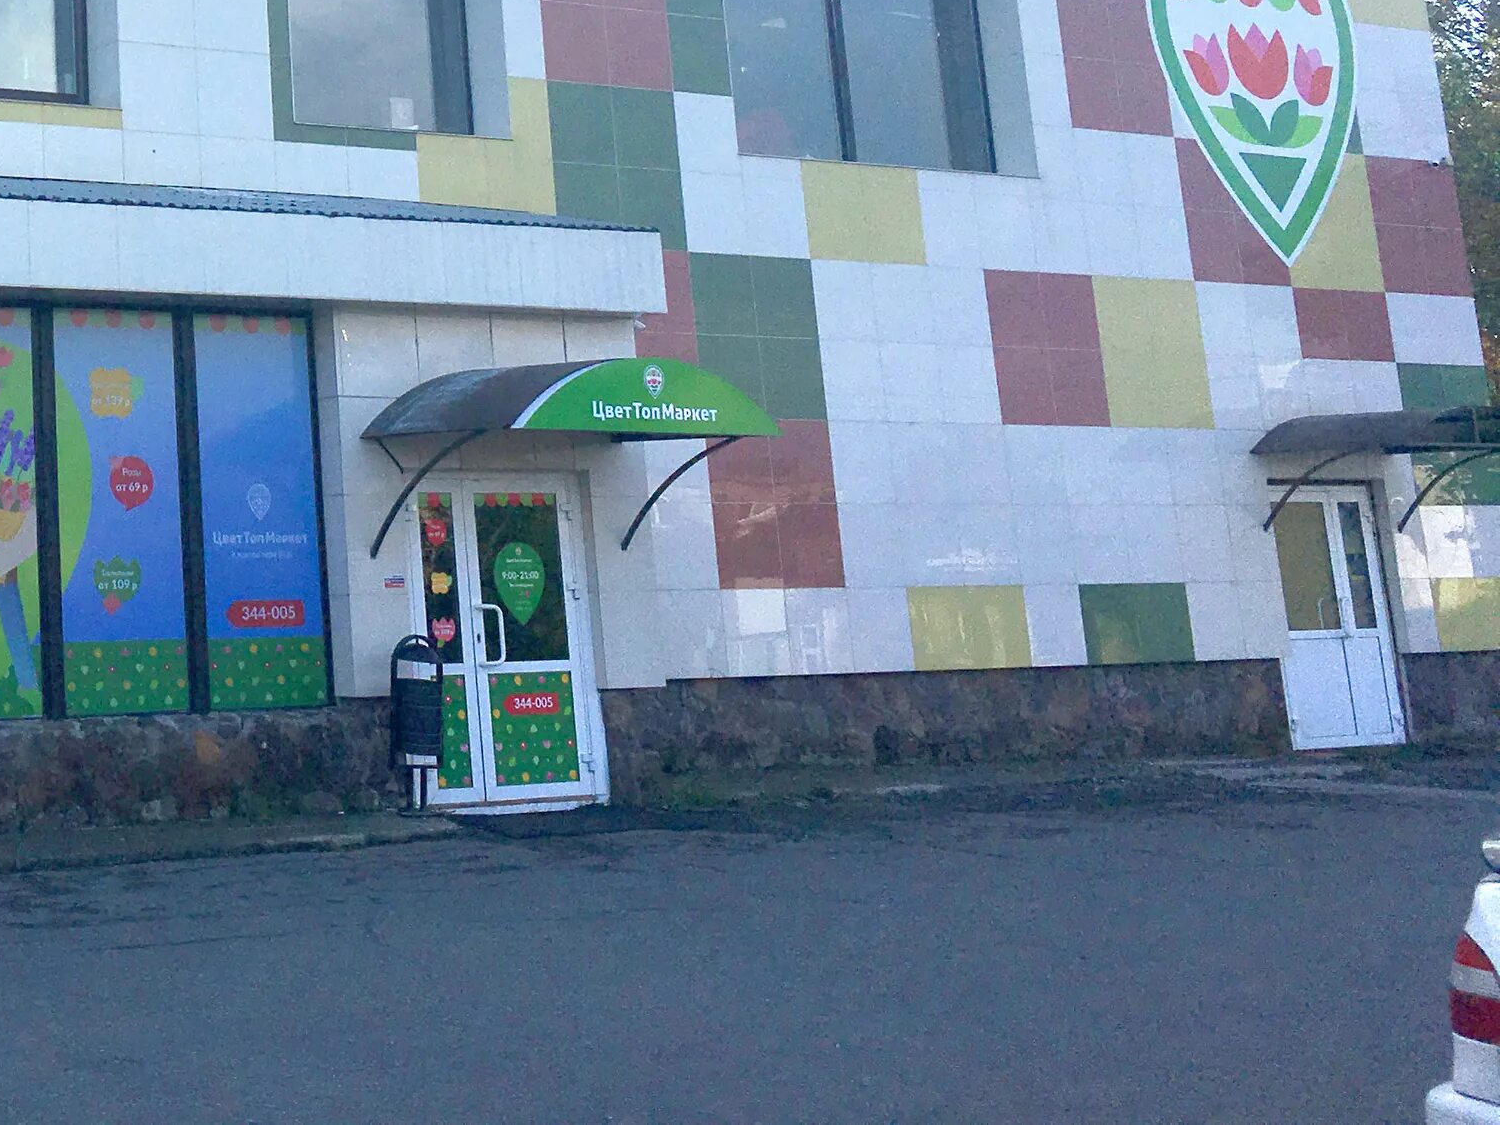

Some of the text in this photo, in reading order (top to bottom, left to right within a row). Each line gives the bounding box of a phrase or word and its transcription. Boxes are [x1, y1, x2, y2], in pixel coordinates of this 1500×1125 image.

[128, 481, 141, 492] 69
[111, 578, 130, 590] 109
[241, 605, 296, 621] 344-005
[514, 696, 553, 709] 344-005
